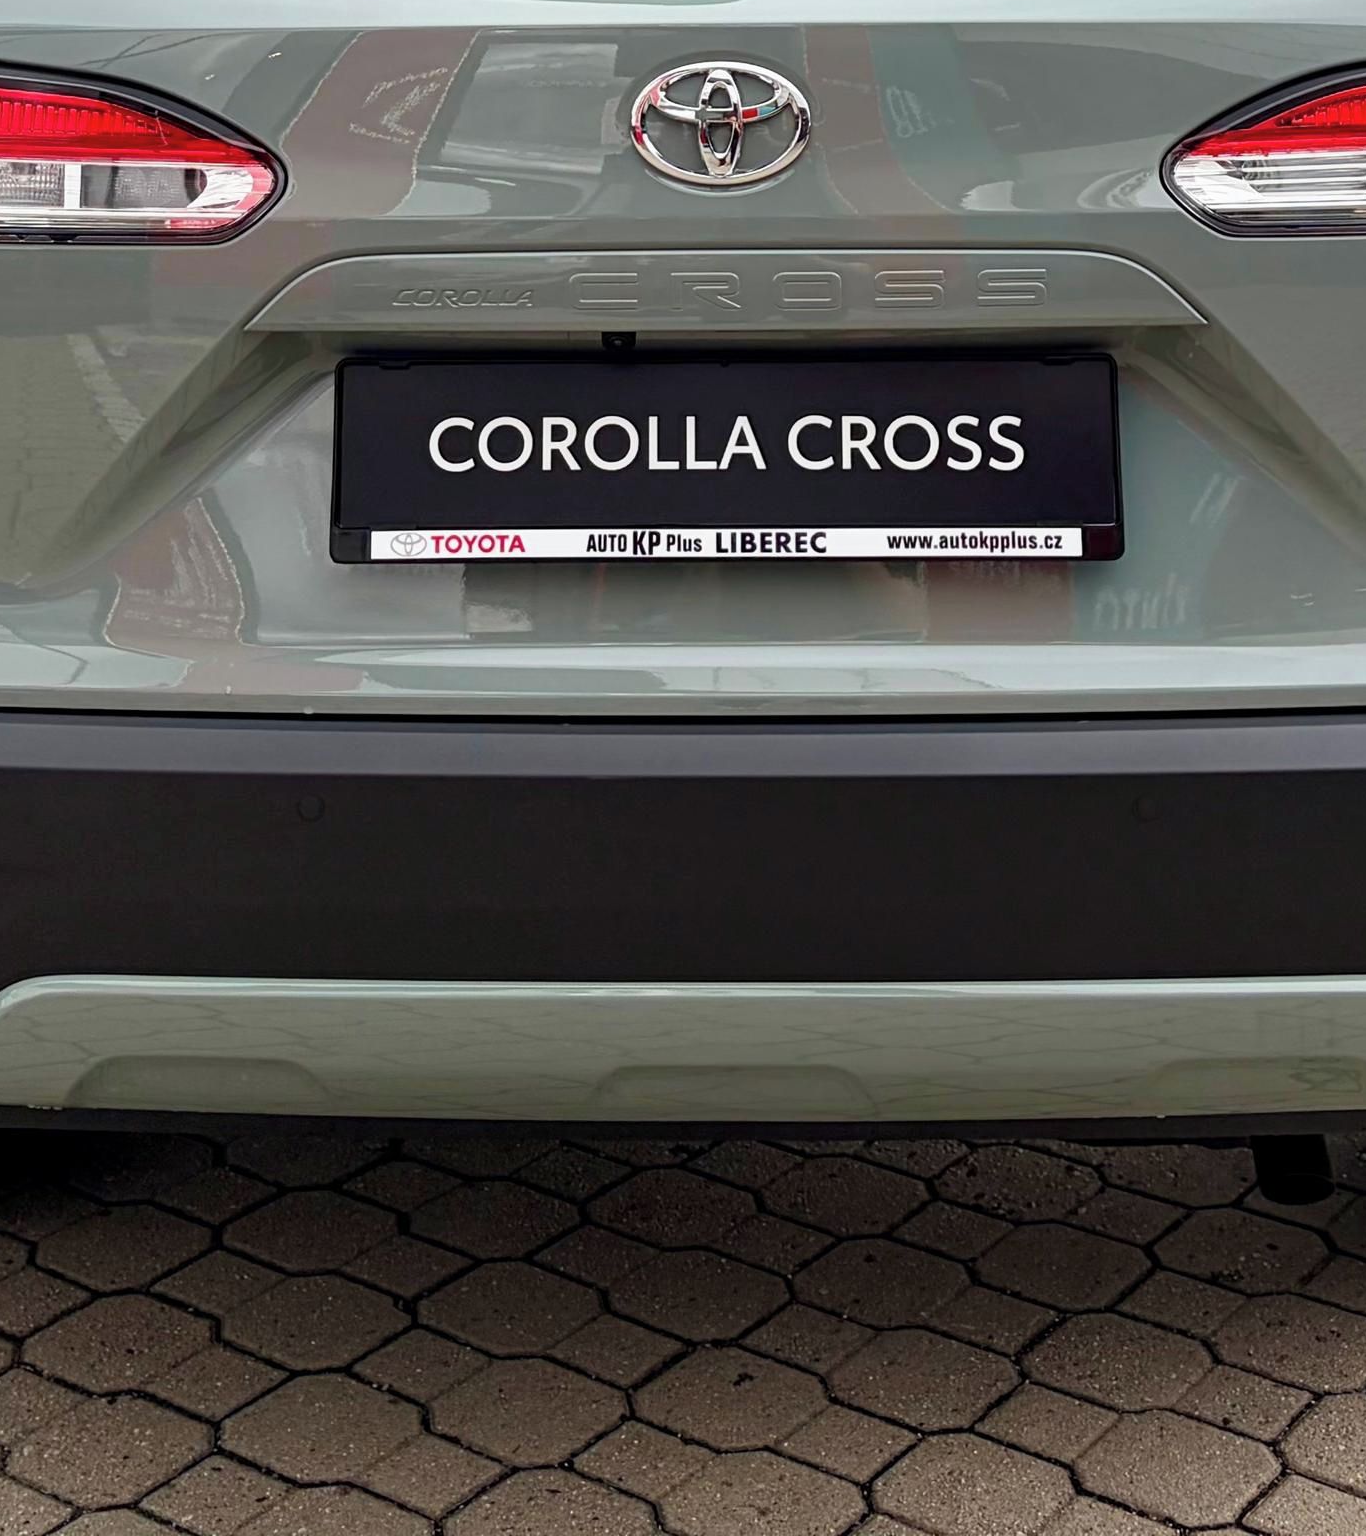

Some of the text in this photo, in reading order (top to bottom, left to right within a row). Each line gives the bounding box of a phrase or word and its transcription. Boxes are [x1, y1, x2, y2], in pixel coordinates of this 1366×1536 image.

[392, 268, 1047, 311] COROLLA CROSS
[429, 414, 1026, 472] COROLLA CROSS
[431, 530, 1063, 556] TOYOTA AUTO KP Plus LIBEREC www.autokpplus.cz
